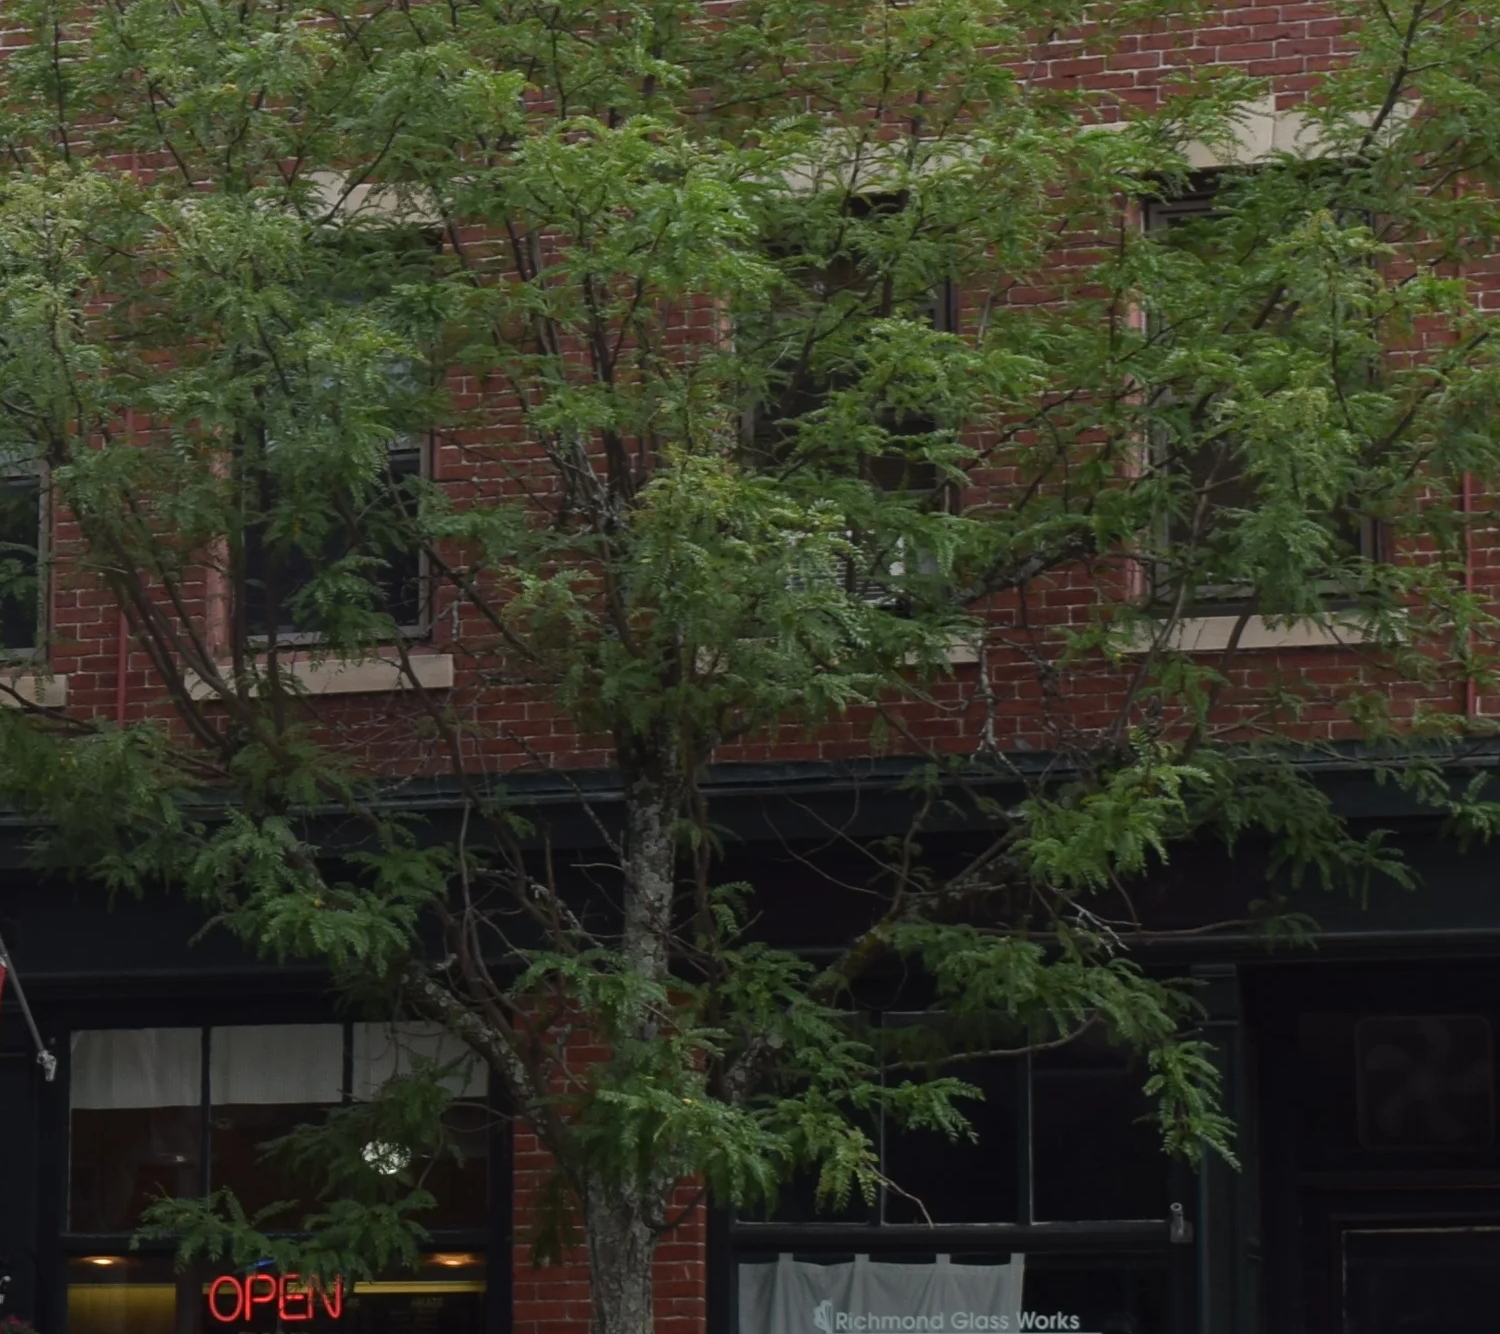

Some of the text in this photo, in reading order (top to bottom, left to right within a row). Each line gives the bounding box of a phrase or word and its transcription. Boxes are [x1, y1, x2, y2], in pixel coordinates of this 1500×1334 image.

[208, 1272, 344, 1323] OPEN
[835, 1310, 1081, 1330] Richmond Glass Works
